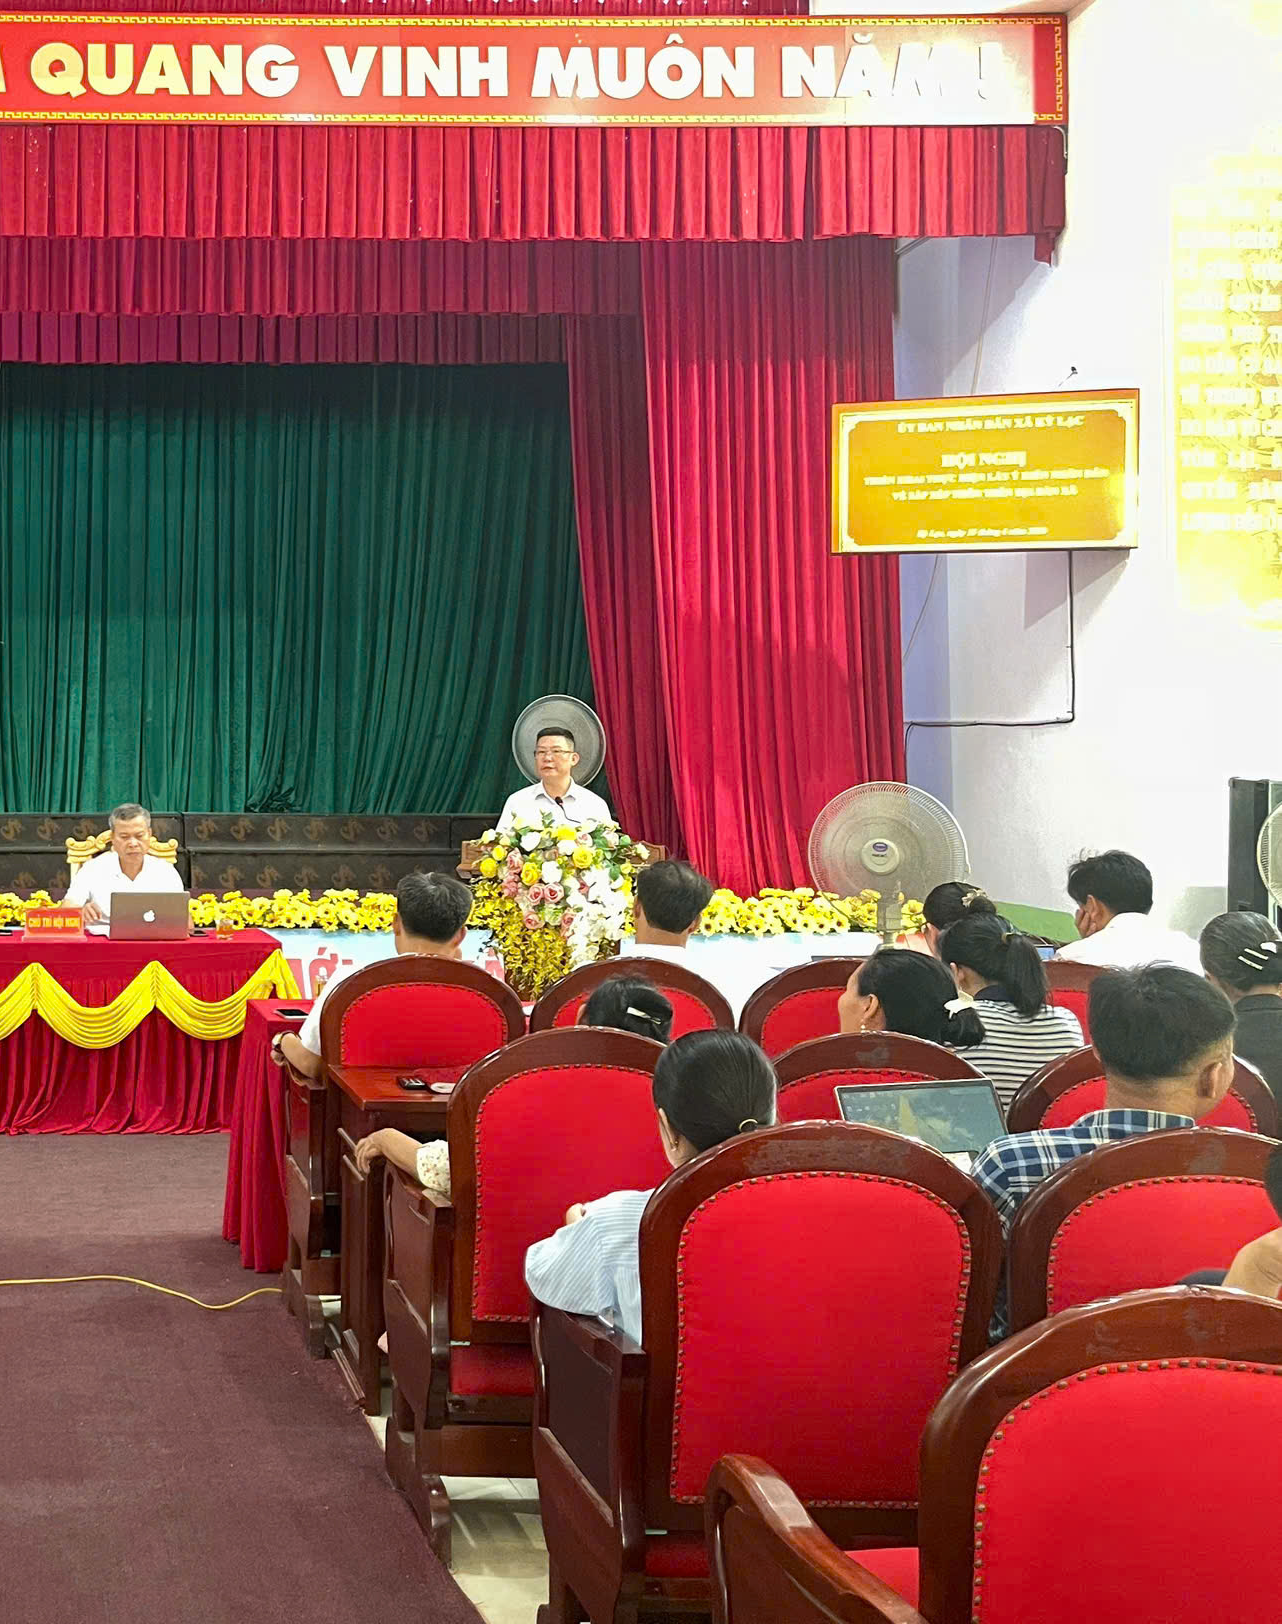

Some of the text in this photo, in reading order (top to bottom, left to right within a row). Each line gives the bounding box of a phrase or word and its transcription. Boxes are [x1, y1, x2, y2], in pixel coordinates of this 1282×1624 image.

[30, 42, 299, 98] QUANG
[324, 46, 508, 97] VINH
[531, 33, 754, 100] MUÔN
